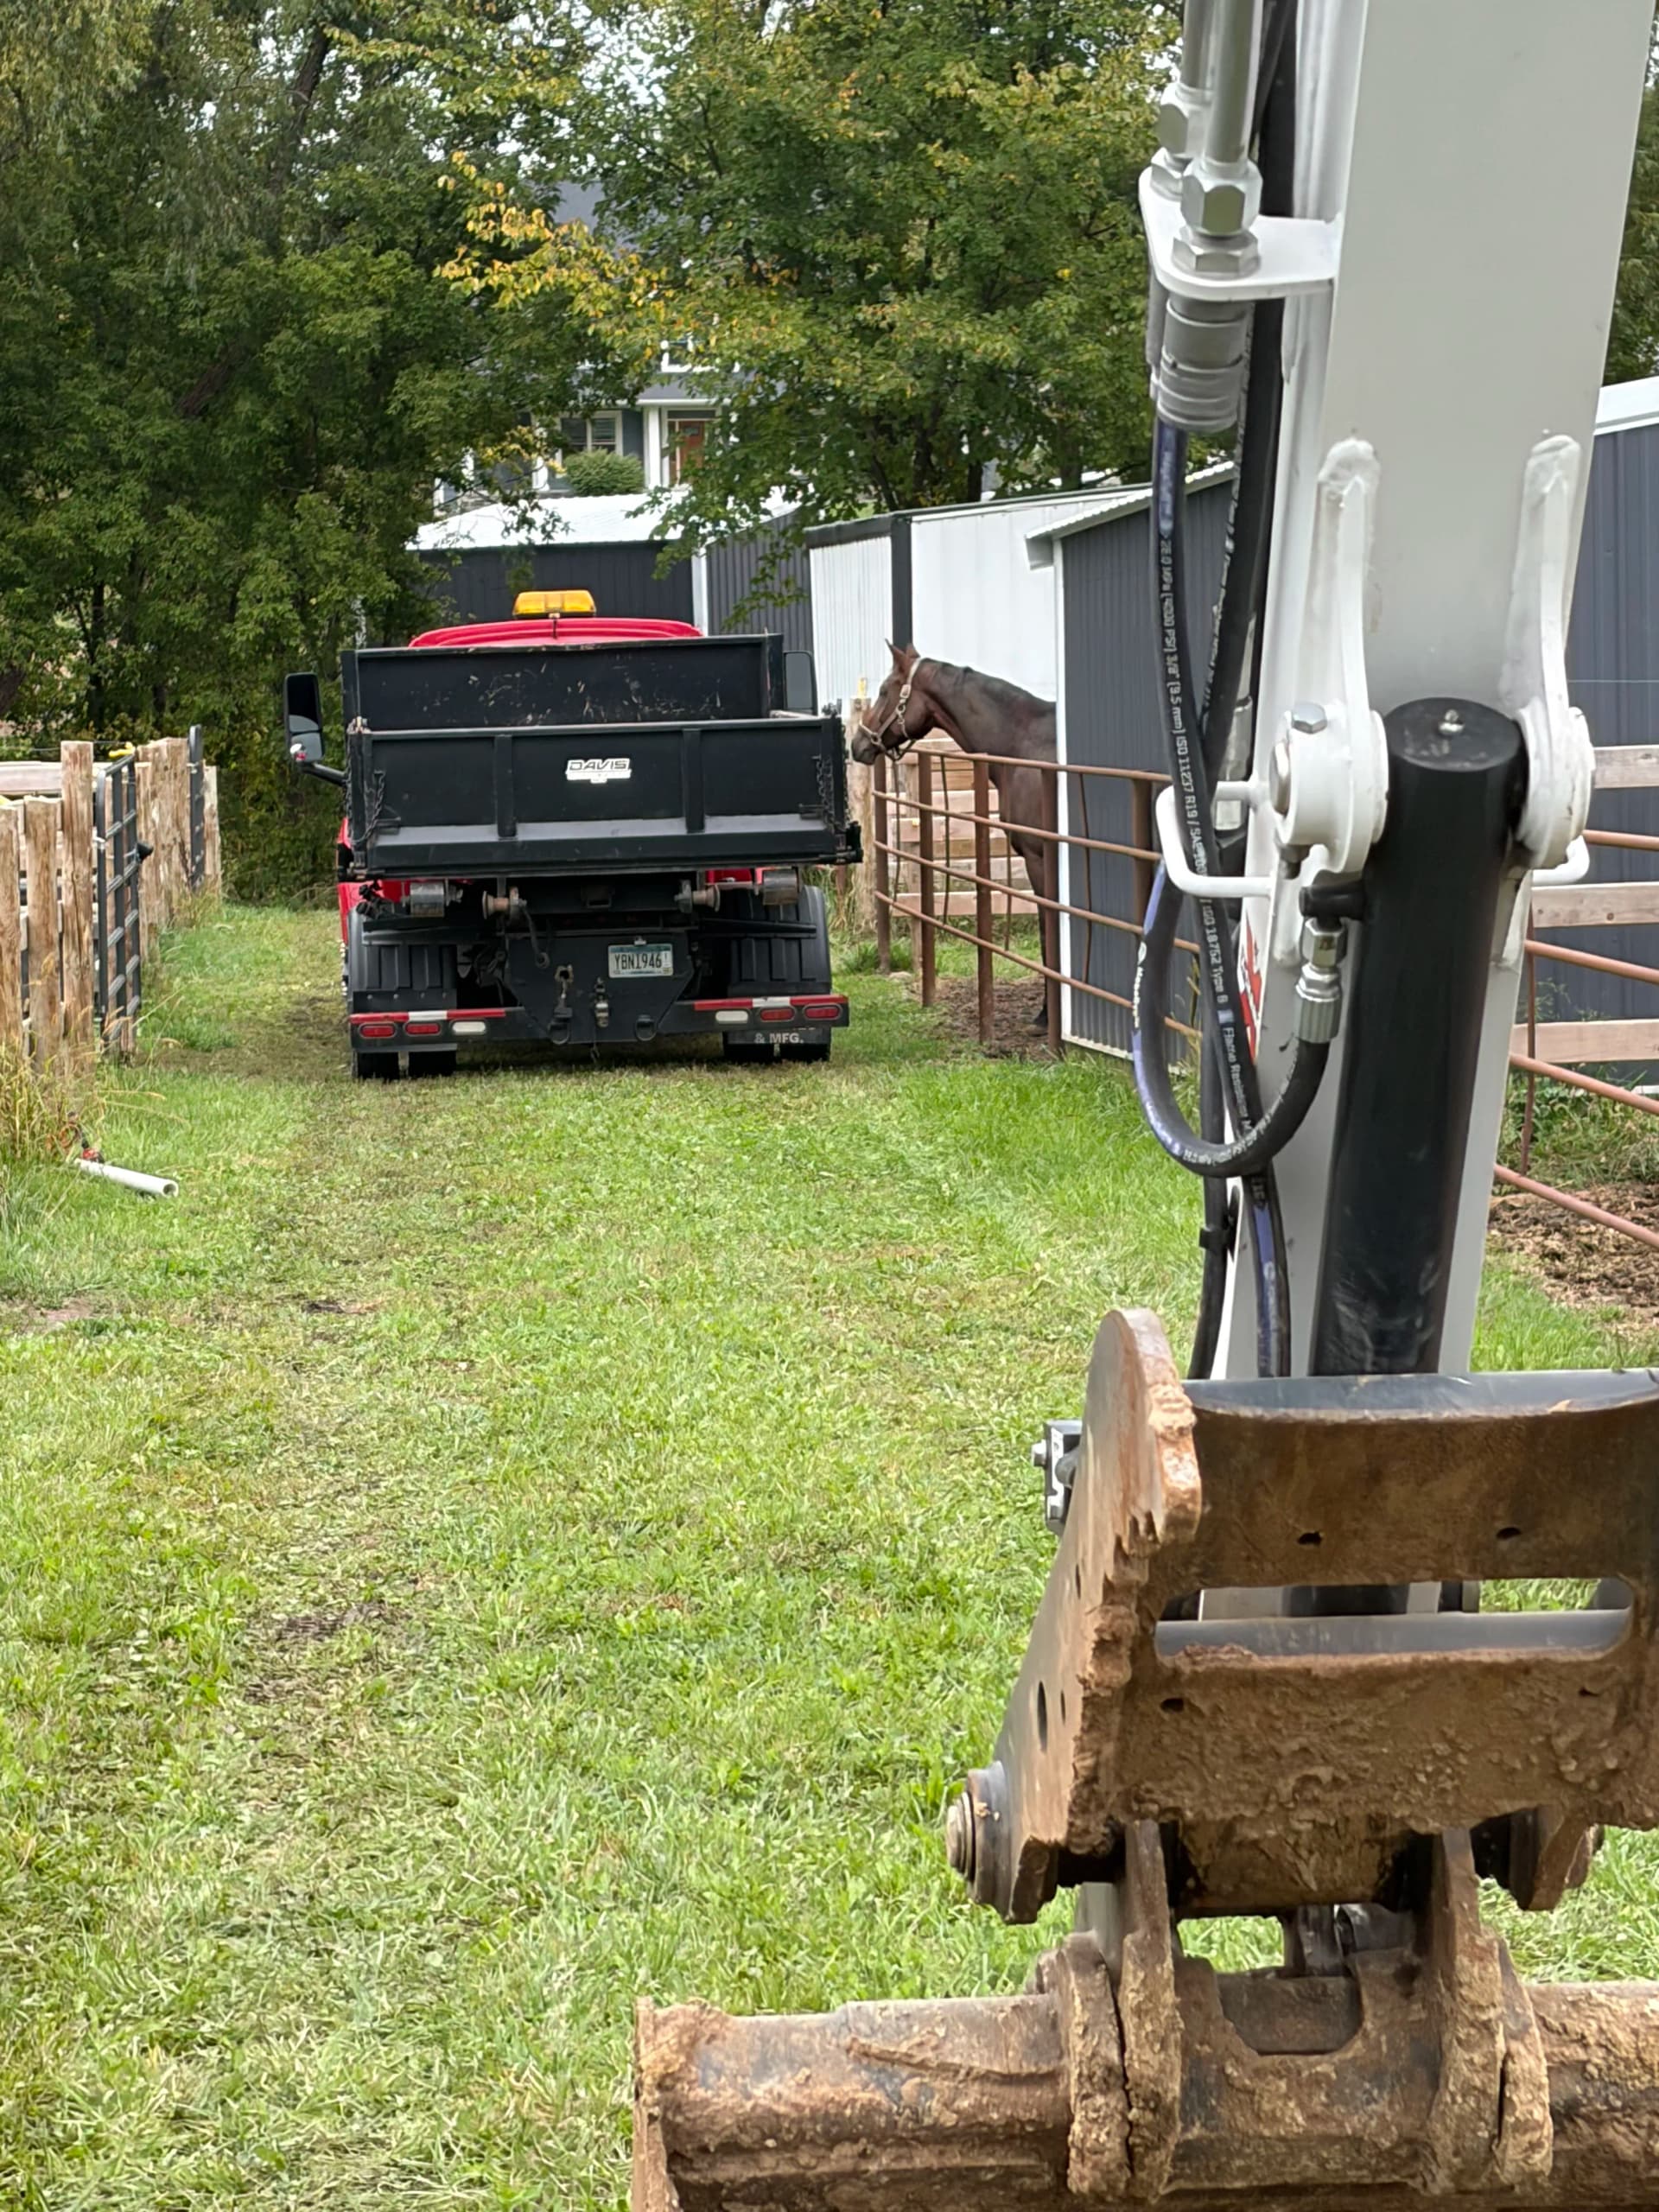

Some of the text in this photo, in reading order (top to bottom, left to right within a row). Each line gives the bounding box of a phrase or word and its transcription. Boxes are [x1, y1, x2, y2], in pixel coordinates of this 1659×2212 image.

[1166, 681, 1183, 704] (9.5
[1172, 707, 1187, 734] mm)
[1176, 735, 1189, 755] ISO
[569, 760, 628, 771] DAVIS
[1178, 758, 1195, 792] 11237
[1184, 795, 1198, 819] R19
[1205, 927, 1223, 964] 18752
[614, 952, 662, 970] YBN1946
[1211, 966, 1225, 993] Type
[753, 1032, 804, 1044] & MFG.
[1223, 1027, 1239, 1063] Flame
